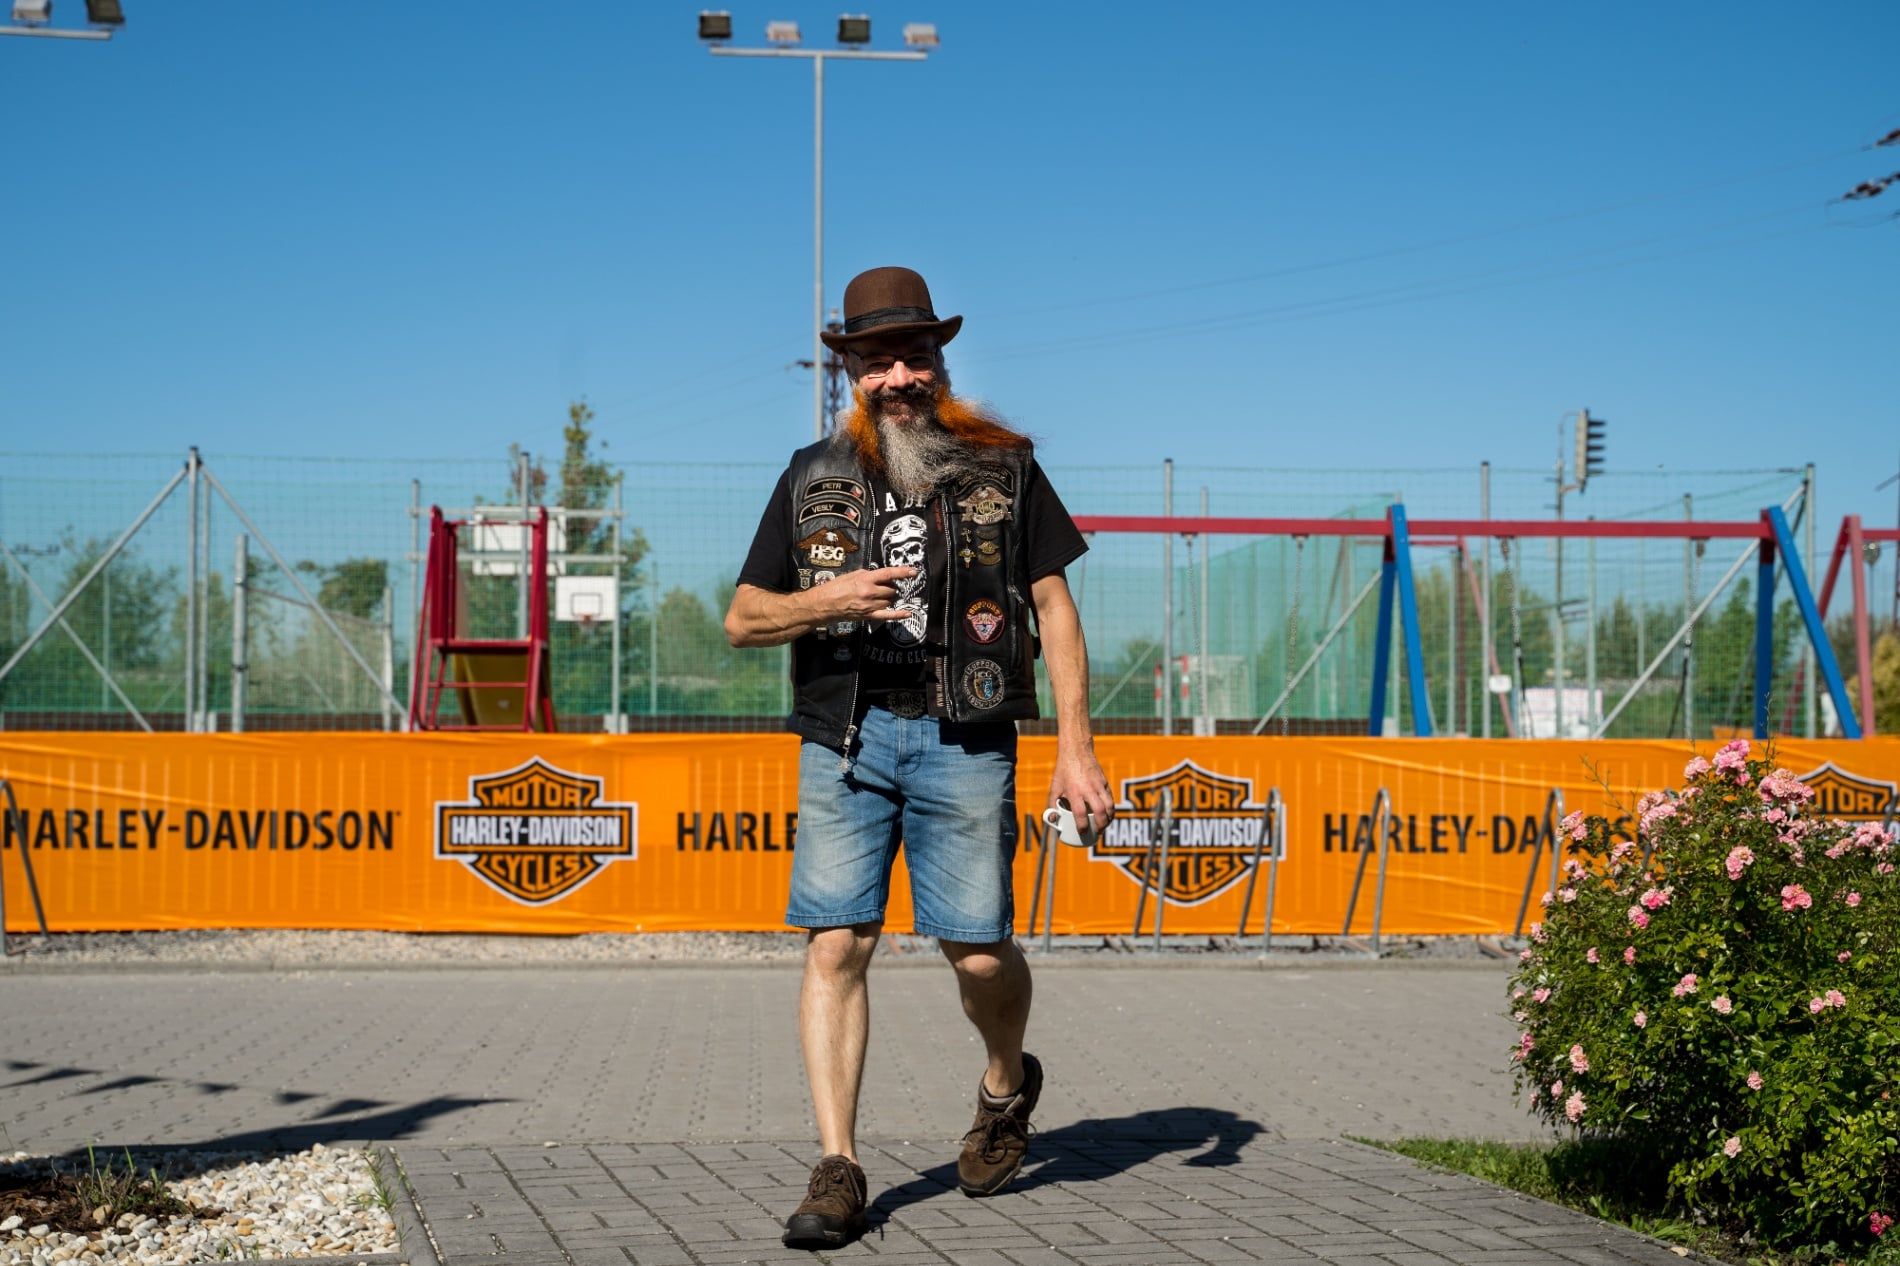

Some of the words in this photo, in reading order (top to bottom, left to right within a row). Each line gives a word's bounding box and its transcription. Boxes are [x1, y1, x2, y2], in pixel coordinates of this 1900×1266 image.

[822, 482, 842, 490] PETR
[491, 776, 581, 807] MOTOR
[4, 809, 393, 850] HARLEY-DAVIDSON
[452, 816, 621, 845] HARLEY-DAVIDSON
[491, 854, 581, 892] CYCLES
